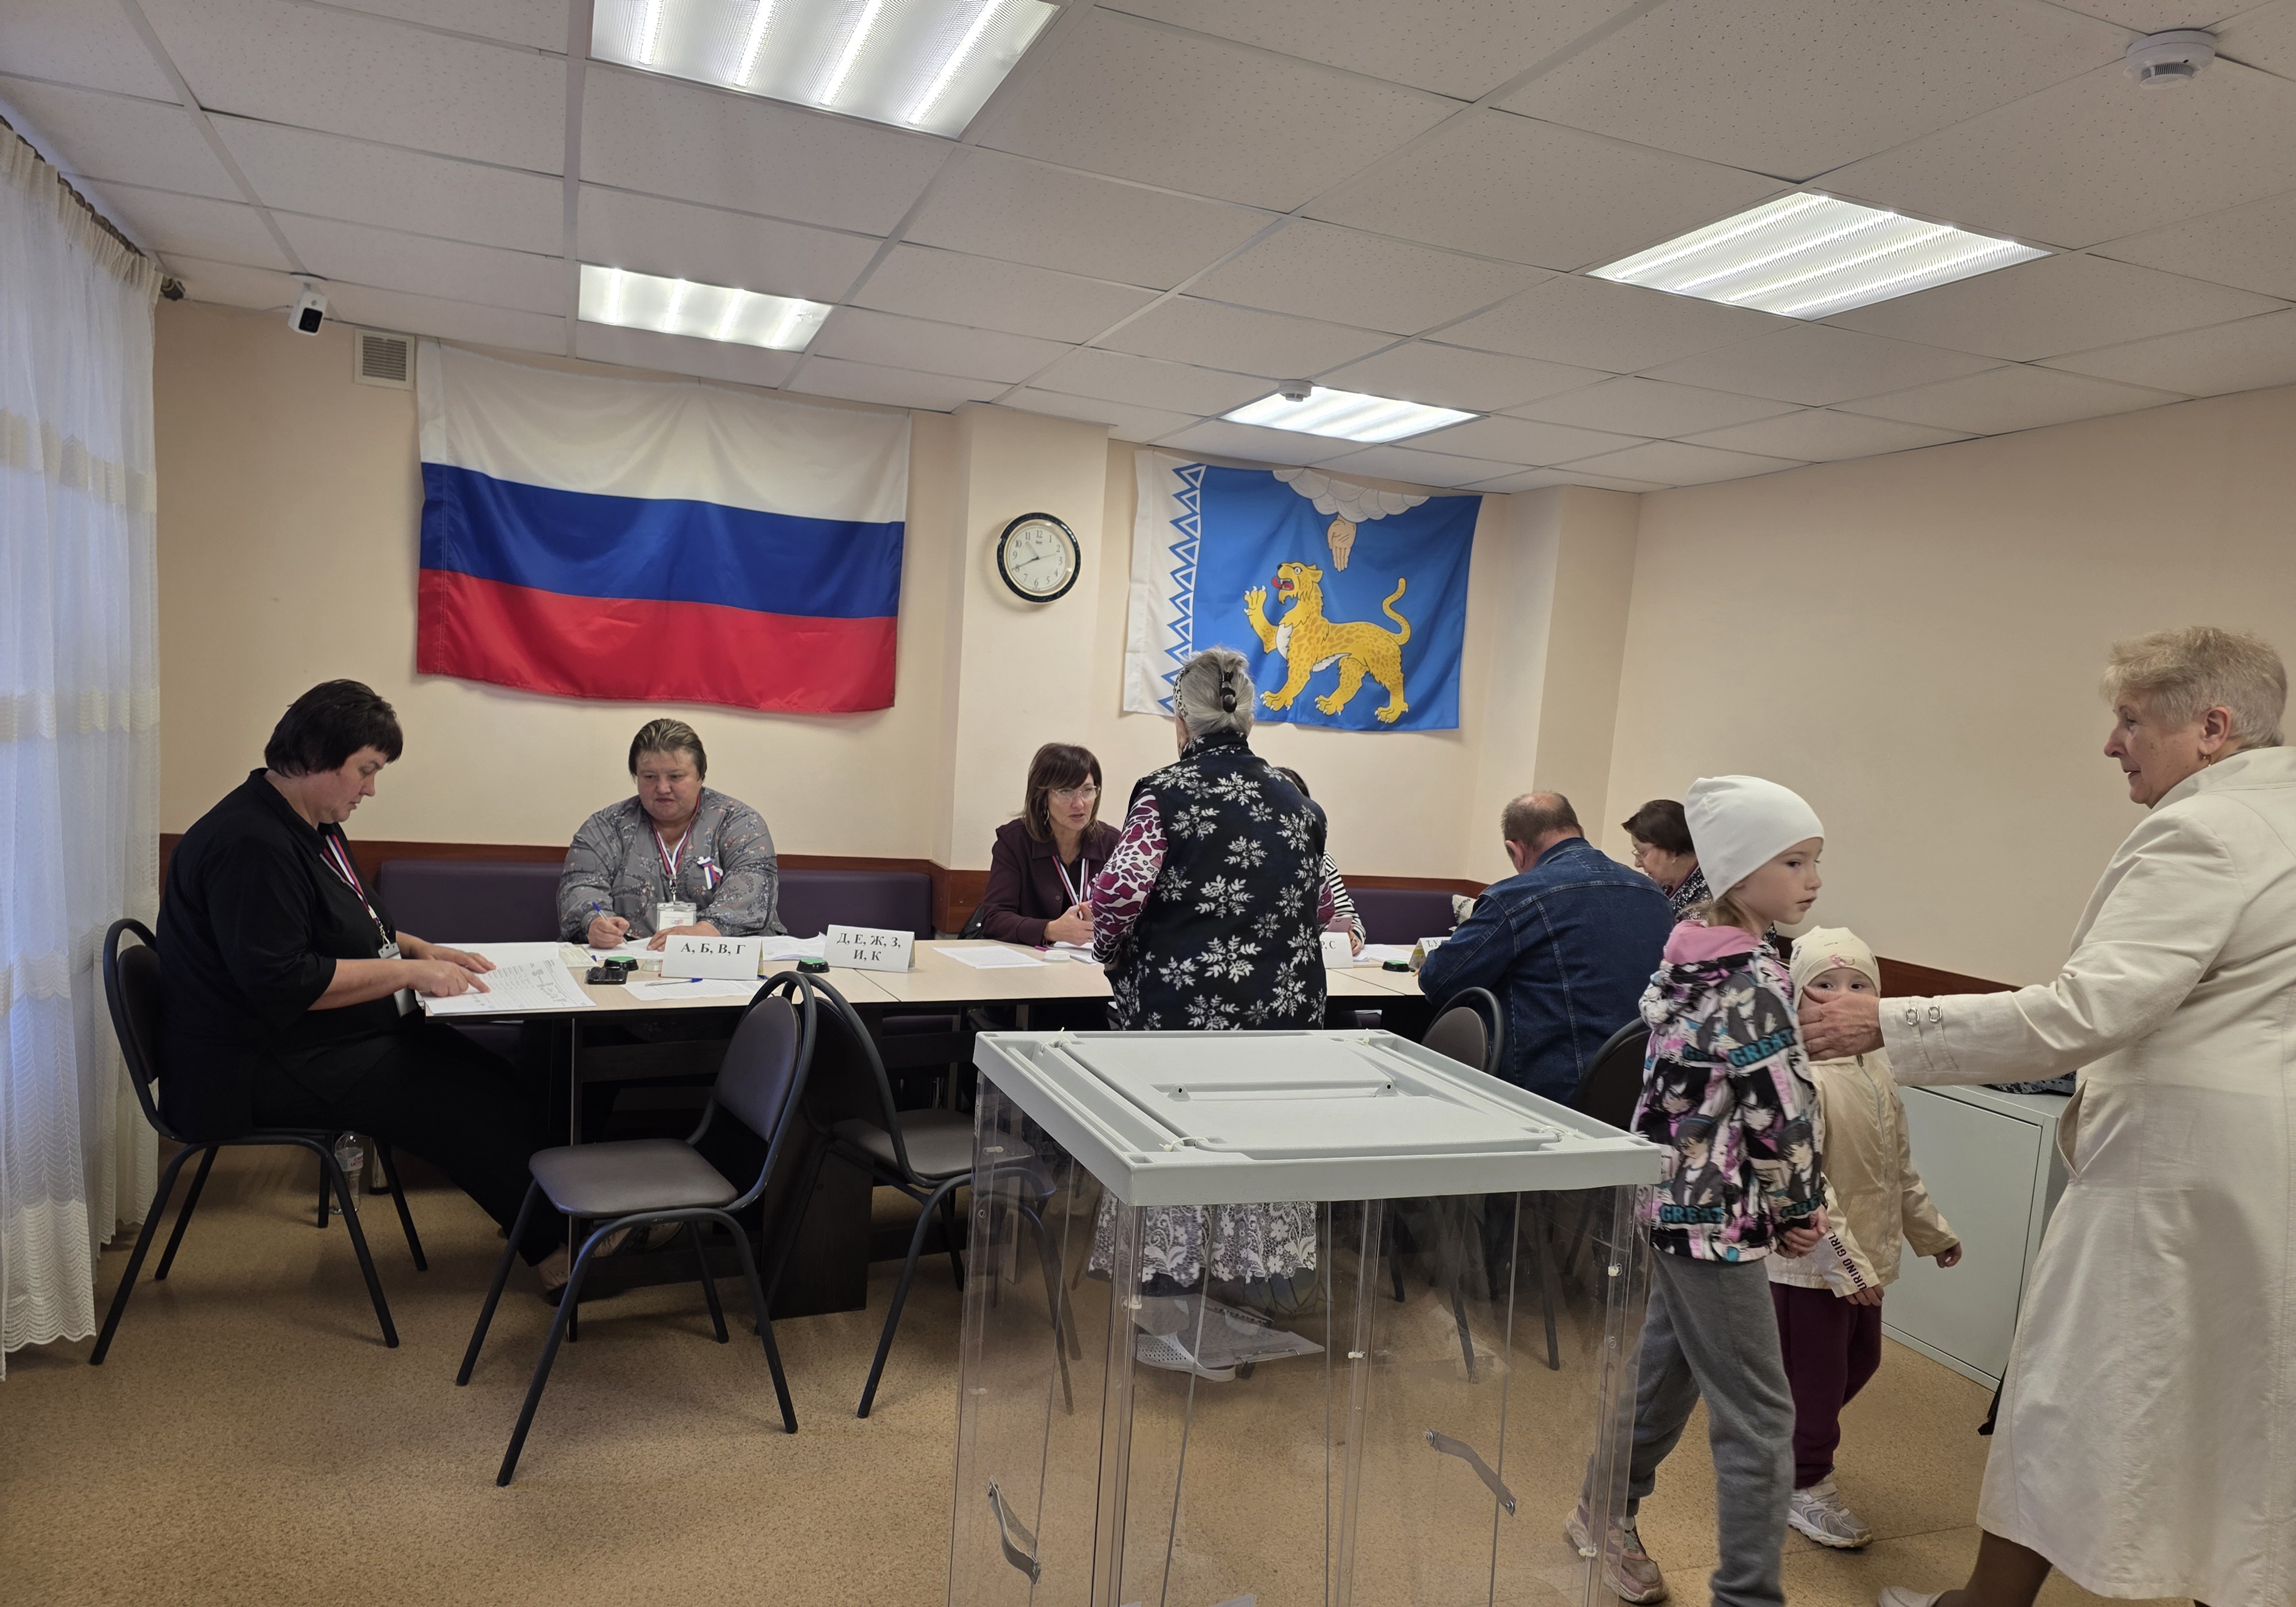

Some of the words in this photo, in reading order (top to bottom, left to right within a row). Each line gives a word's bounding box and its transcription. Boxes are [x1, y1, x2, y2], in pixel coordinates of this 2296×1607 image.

[1025, 531, 1030, 540] 11
[1036, 530, 1043, 538] 12
[1015, 539, 1022, 548] 10
[1049, 535, 1052, 543] 1
[1056, 545, 1061, 553] 2
[1013, 552, 1018, 560] 9
[1058, 557, 1062, 565] 3
[1015, 564, 1020, 572] 8
[1054, 568, 1058, 577] 4
[1034, 578, 1039, 587] 6
[1046, 576, 1050, 584] 5
[836, 933, 850, 945] Д,
[854, 934, 866, 946] Е,
[870, 935, 886, 948] Ж,
[890, 937, 901, 949] З,
[1329, 940, 1336, 949] С
[681, 942, 695, 954] А,
[700, 943, 713, 955] Б,
[718, 944, 731, 956] В,
[736, 945, 746, 954] Г
[854, 949, 867, 962] И,
[871, 951, 881, 961] К
[1728, 1028, 1793, 1066] GREAT
[1828, 1232, 1847, 1257] GIRL
